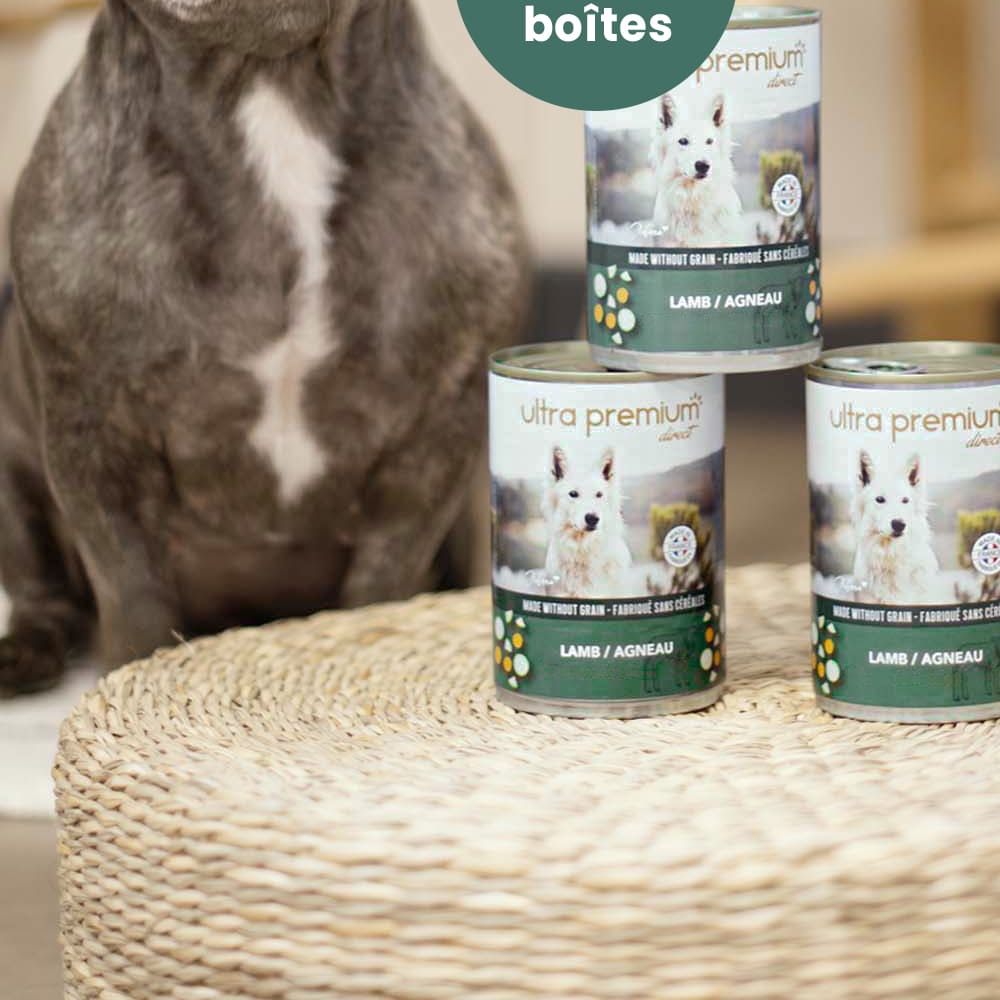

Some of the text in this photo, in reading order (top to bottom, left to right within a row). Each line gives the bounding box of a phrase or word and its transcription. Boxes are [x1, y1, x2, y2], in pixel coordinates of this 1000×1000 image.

[696, 47, 804, 83] premium
[628, 252, 649, 265] MADE
[650, 252, 688, 265] WITHOUT
[690, 253, 716, 265] GRAIN
[723, 248, 762, 264] FABRIQUÉ
[764, 249, 782, 263] SANS
[669, 296, 711, 309] LAMB
[724, 292, 782, 308] AGNEAU
[520, 398, 700, 437] ultra premium
[830, 402, 882, 431] ultra
[522, 600, 542, 613] MADE
[543, 601, 578, 615] WITHOUT
[579, 603, 605, 616] GRAIN
[612, 599, 652, 615] FABRIQUÉ
[654, 600, 674, 613] SANS
[832, 605, 851, 617] MADE
[851, 606, 885, 621] WITHOUT
[887, 609, 912, 622] GRAIN
[919, 605, 960, 622] FABRIQUÉ
[962, 607, 983, 620] SANS
[560, 645, 600, 658] LAMB
[614, 642, 674, 658] AGNEAU
[868, 651, 908, 665] LAMB
[921, 649, 983, 665] AGNEAU
